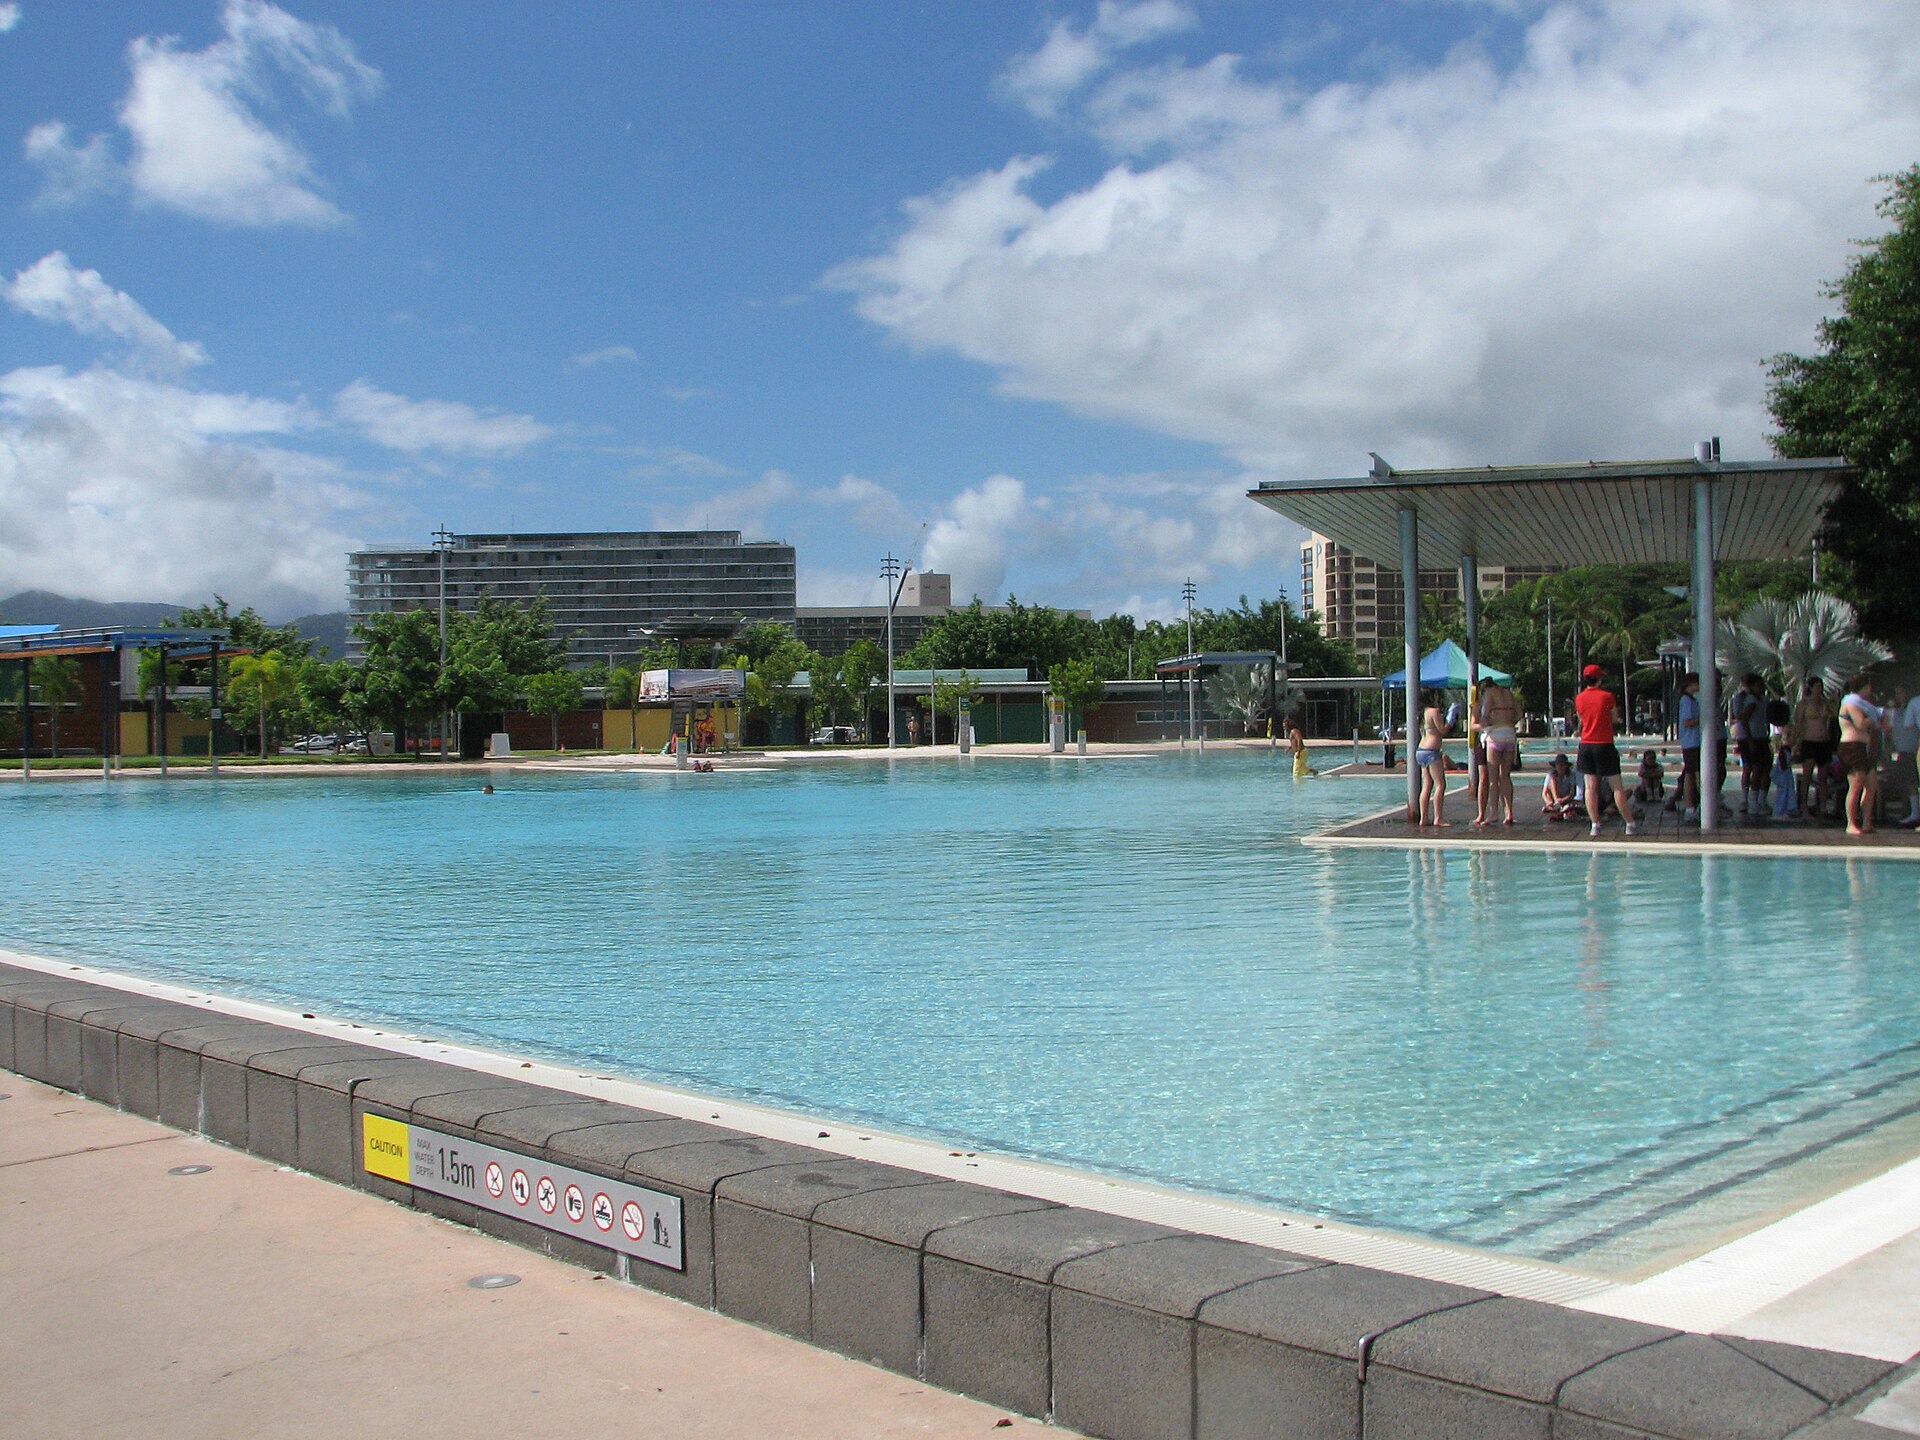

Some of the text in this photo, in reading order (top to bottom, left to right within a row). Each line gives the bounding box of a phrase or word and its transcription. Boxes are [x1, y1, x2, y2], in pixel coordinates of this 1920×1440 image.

[370, 1137, 403, 1158] CAUTION
[414, 1152, 434, 1165] WATER
[415, 1164, 434, 1178] DEPTH
[439, 1147, 475, 1190] 1.5m
